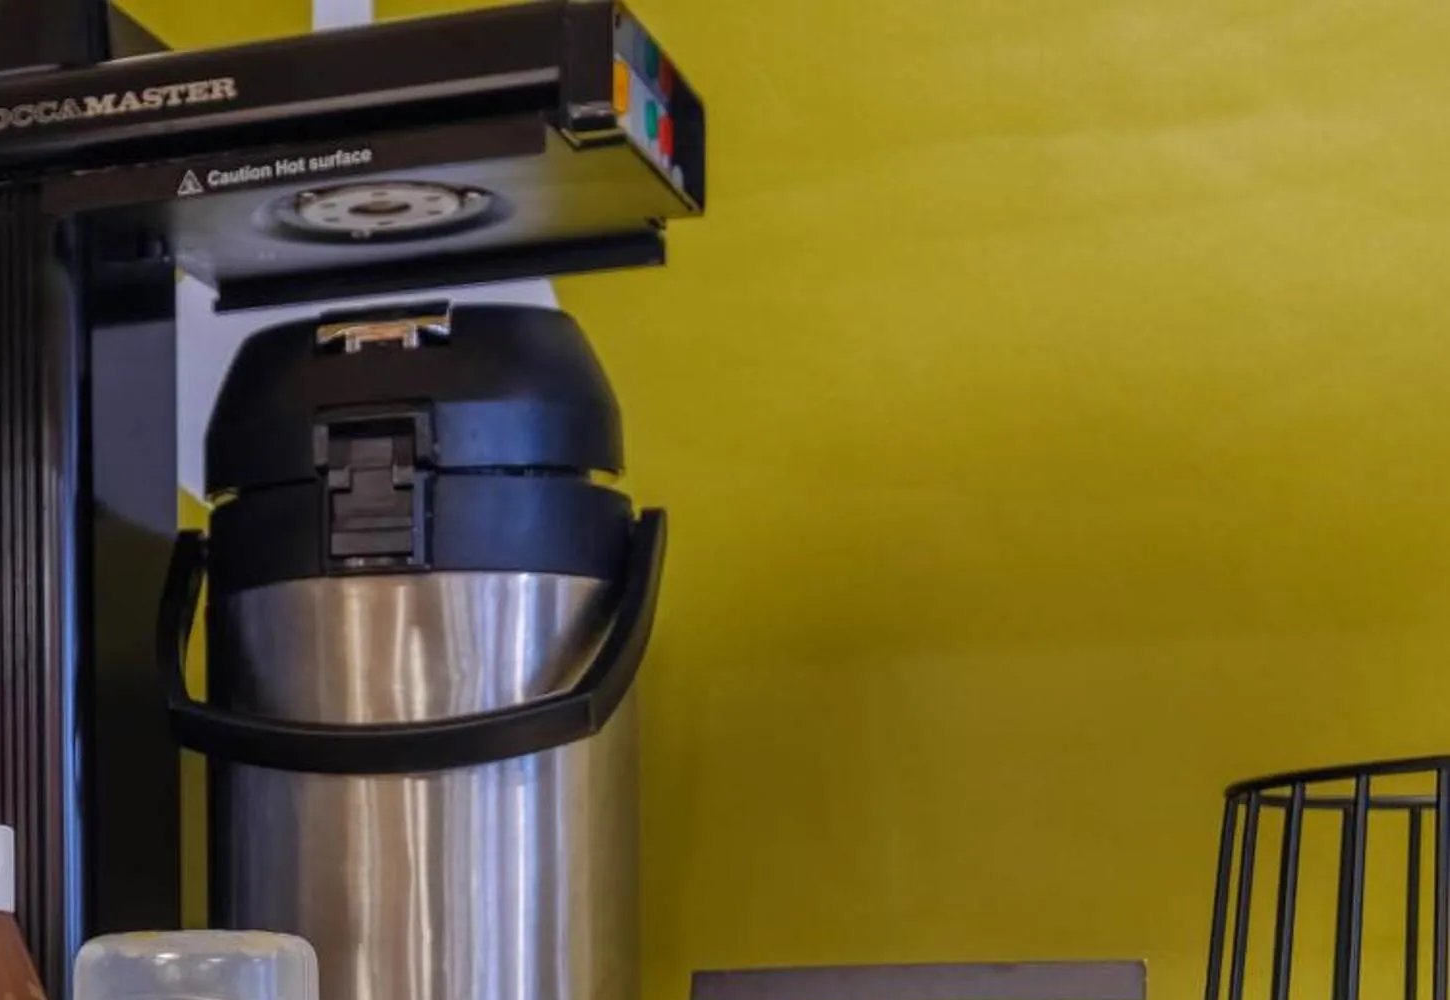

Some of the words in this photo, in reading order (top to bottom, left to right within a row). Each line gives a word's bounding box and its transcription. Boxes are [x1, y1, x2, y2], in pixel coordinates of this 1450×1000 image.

[207, 161, 272, 188] Caution
[275, 157, 305, 178] Hot
[308, 146, 373, 173] surface
